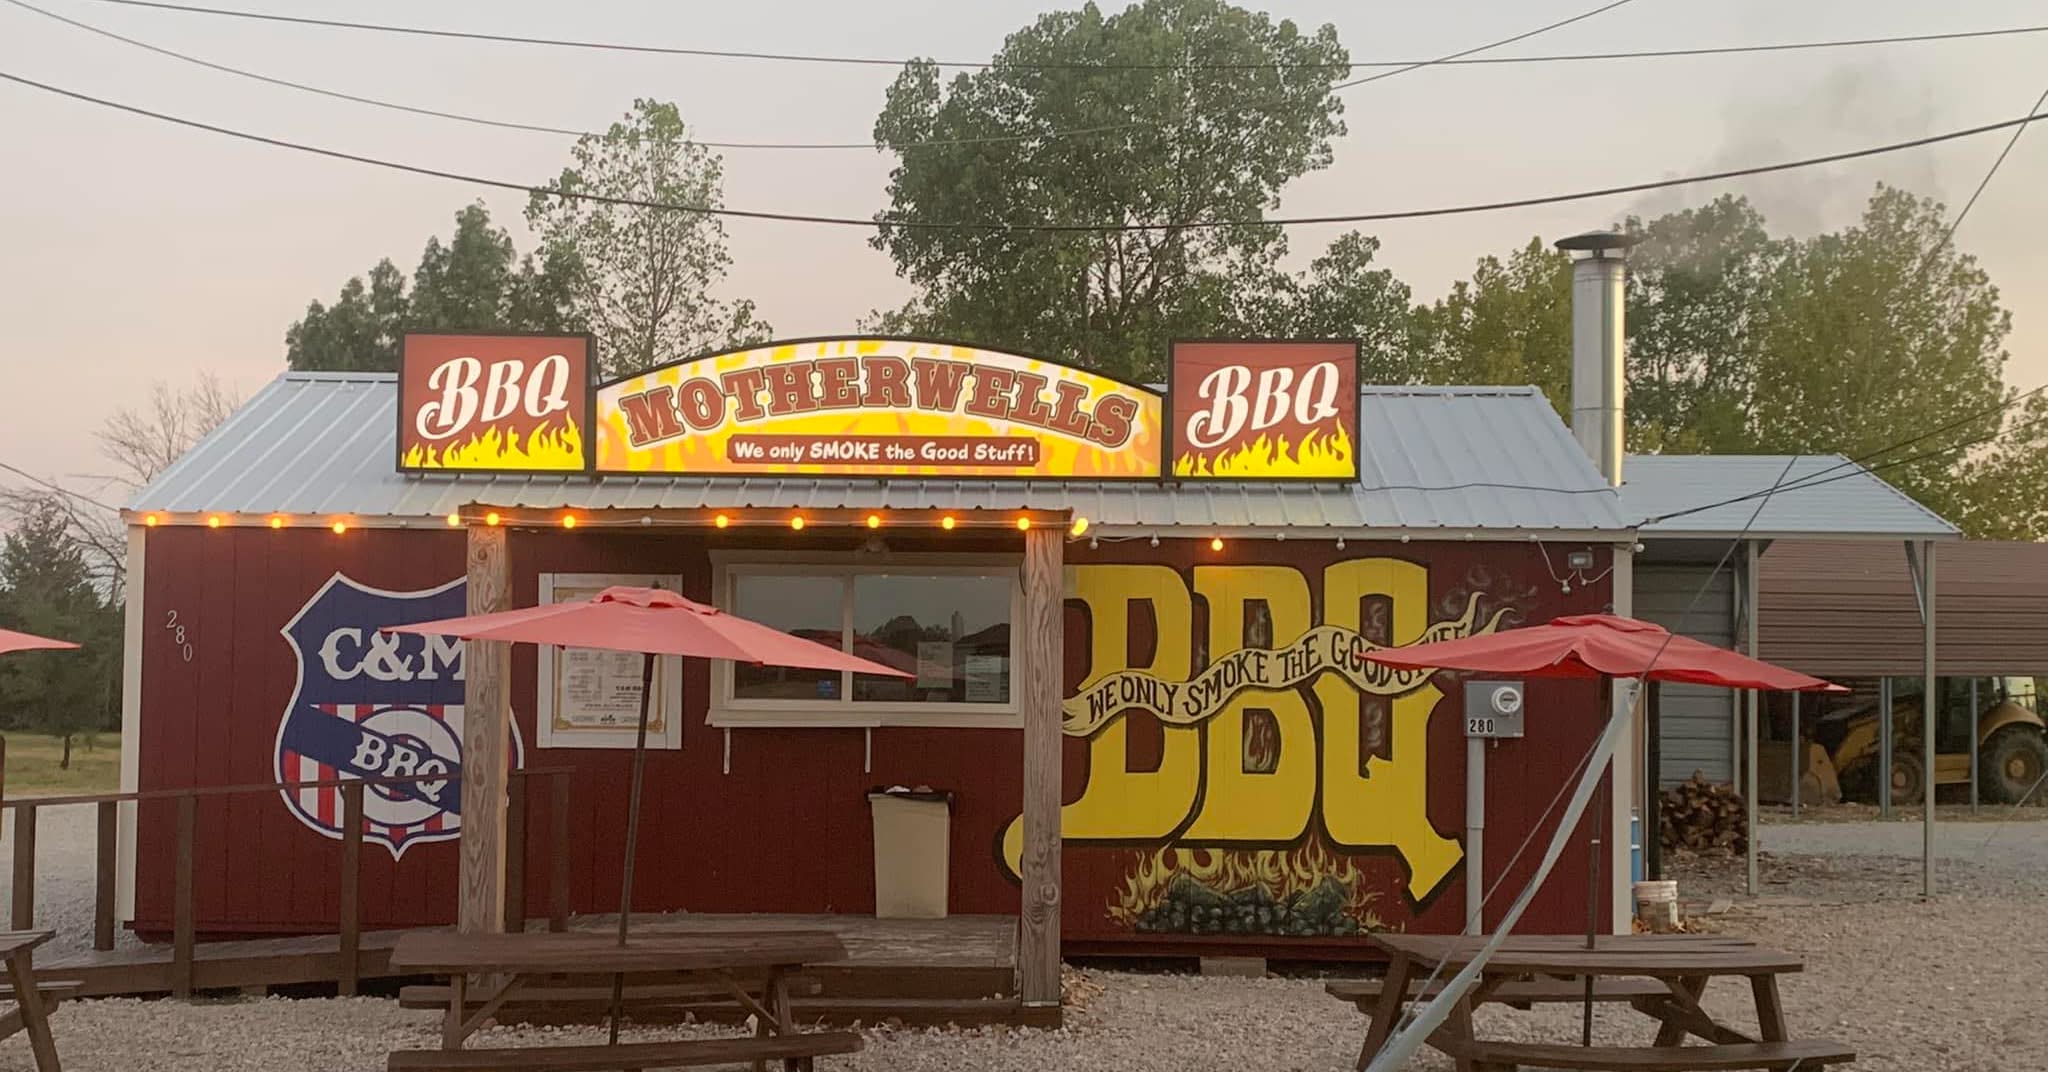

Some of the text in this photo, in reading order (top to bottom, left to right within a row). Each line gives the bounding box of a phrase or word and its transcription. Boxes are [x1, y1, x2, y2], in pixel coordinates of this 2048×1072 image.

[415, 354, 571, 440] BBQ
[618, 355, 1139, 448] MOTHERWELLS
[1186, 361, 1341, 448] BBQ
[734, 441, 1035, 462] We only SMOKE the Good Stuff!
[318, 626, 467, 682] C&M
[1086, 680, 1117, 725] WE
[1120, 674, 1179, 716] ONLY
[1182, 650, 1270, 717] SMOKE
[1276, 634, 1323, 682] THE
[350, 730, 449, 803] BBQ
[1001, 556, 1464, 902] BBQ
[1469, 718, 1495, 733] 280
